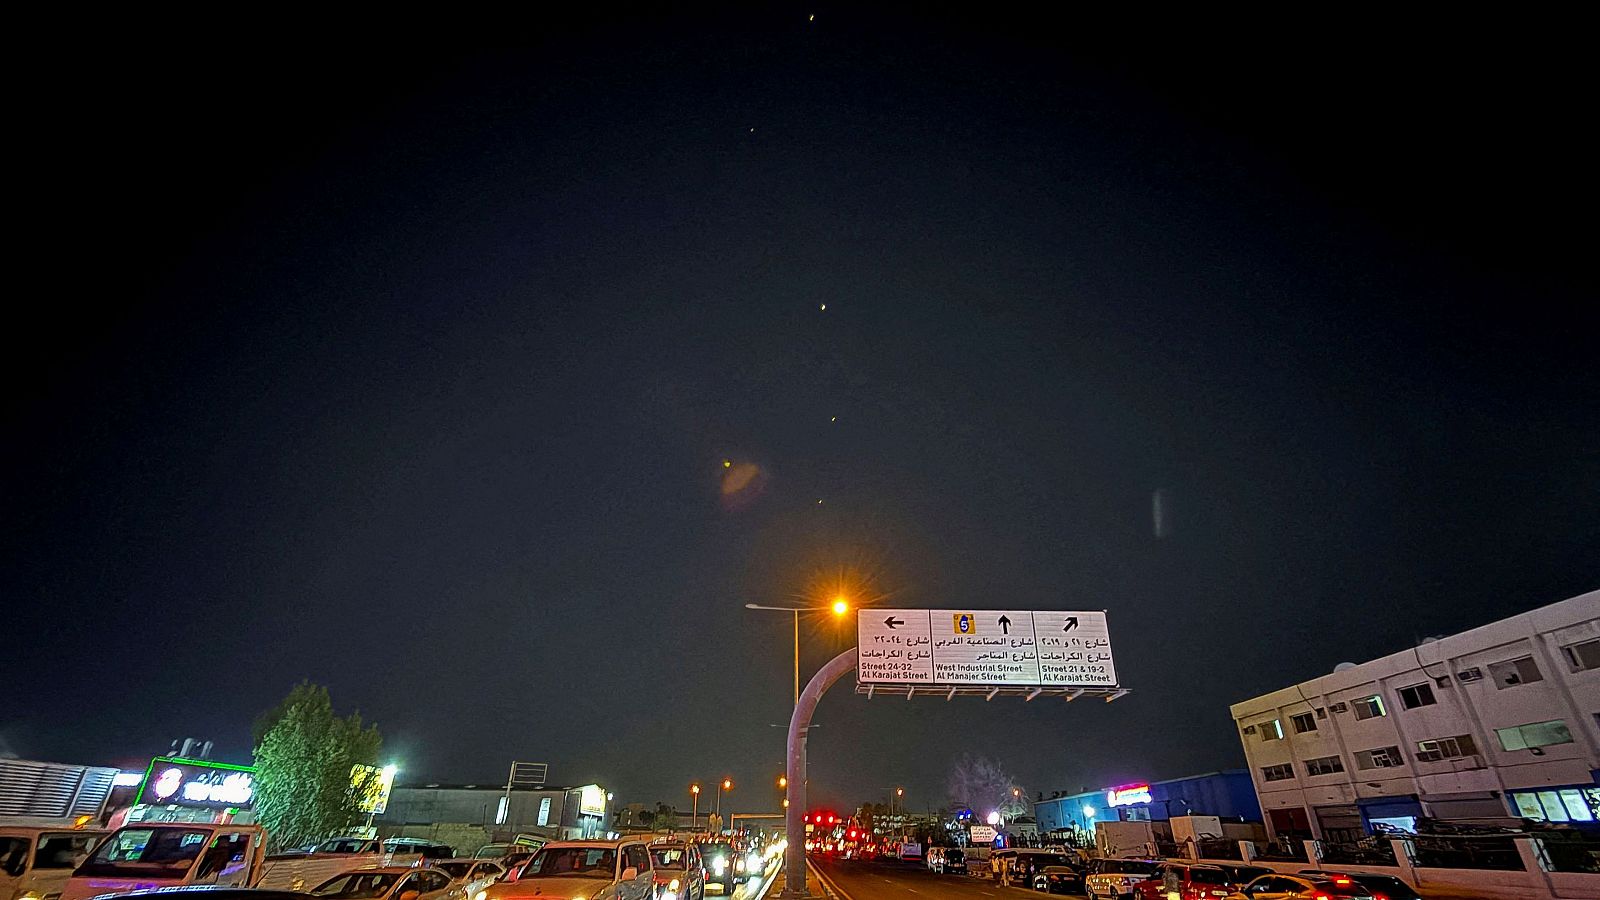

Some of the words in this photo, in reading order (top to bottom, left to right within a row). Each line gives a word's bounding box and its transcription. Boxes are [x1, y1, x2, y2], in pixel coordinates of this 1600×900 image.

[960, 621, 968, 630] 5
[906, 636, 929, 646] شارع
[935, 637, 963, 649] الغربي
[967, 637, 1006, 647] الصناعية
[1010, 638, 1034, 648] شارع
[1085, 638, 1108, 648] شارع
[861, 650, 903, 659] الكراجات
[907, 650, 930, 660] شارع
[1012, 652, 1036, 662] شارع
[1040, 652, 1083, 662] الكراجات
[1087, 653, 1110, 663] شارع
[947, 672, 980, 680] Manajer
[1054, 674, 1083, 682] Karajat
